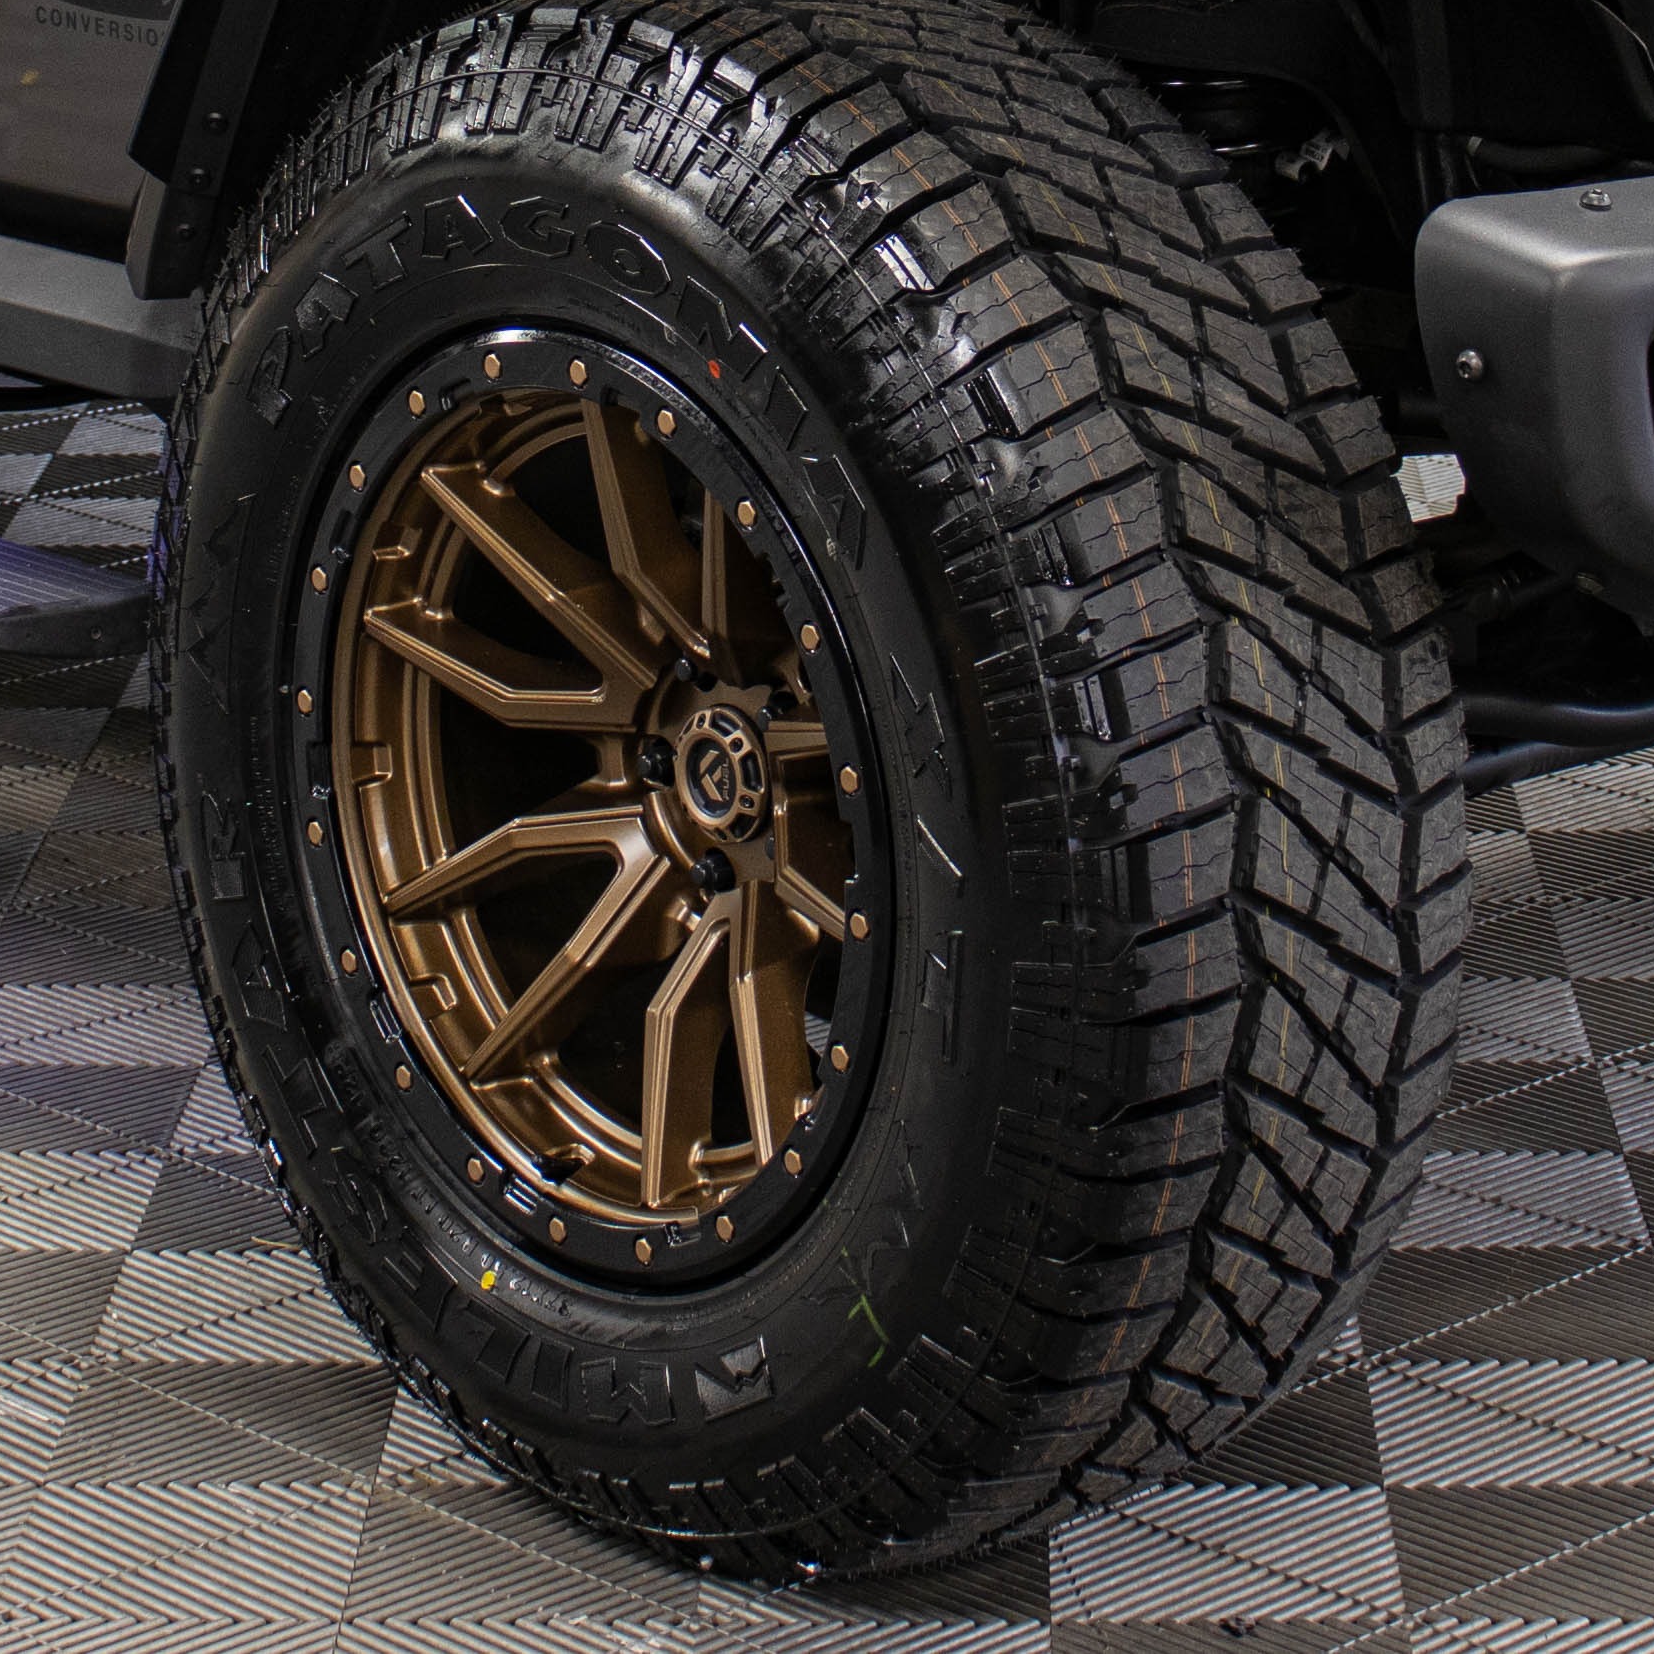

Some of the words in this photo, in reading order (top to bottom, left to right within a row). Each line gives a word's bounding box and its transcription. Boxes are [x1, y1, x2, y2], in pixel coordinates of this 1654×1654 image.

[35, 5, 166, 47] CONVERSIO
[246, 193, 868, 569] PATAGONIA
[195, 794, 679, 1427] MILESTAR
